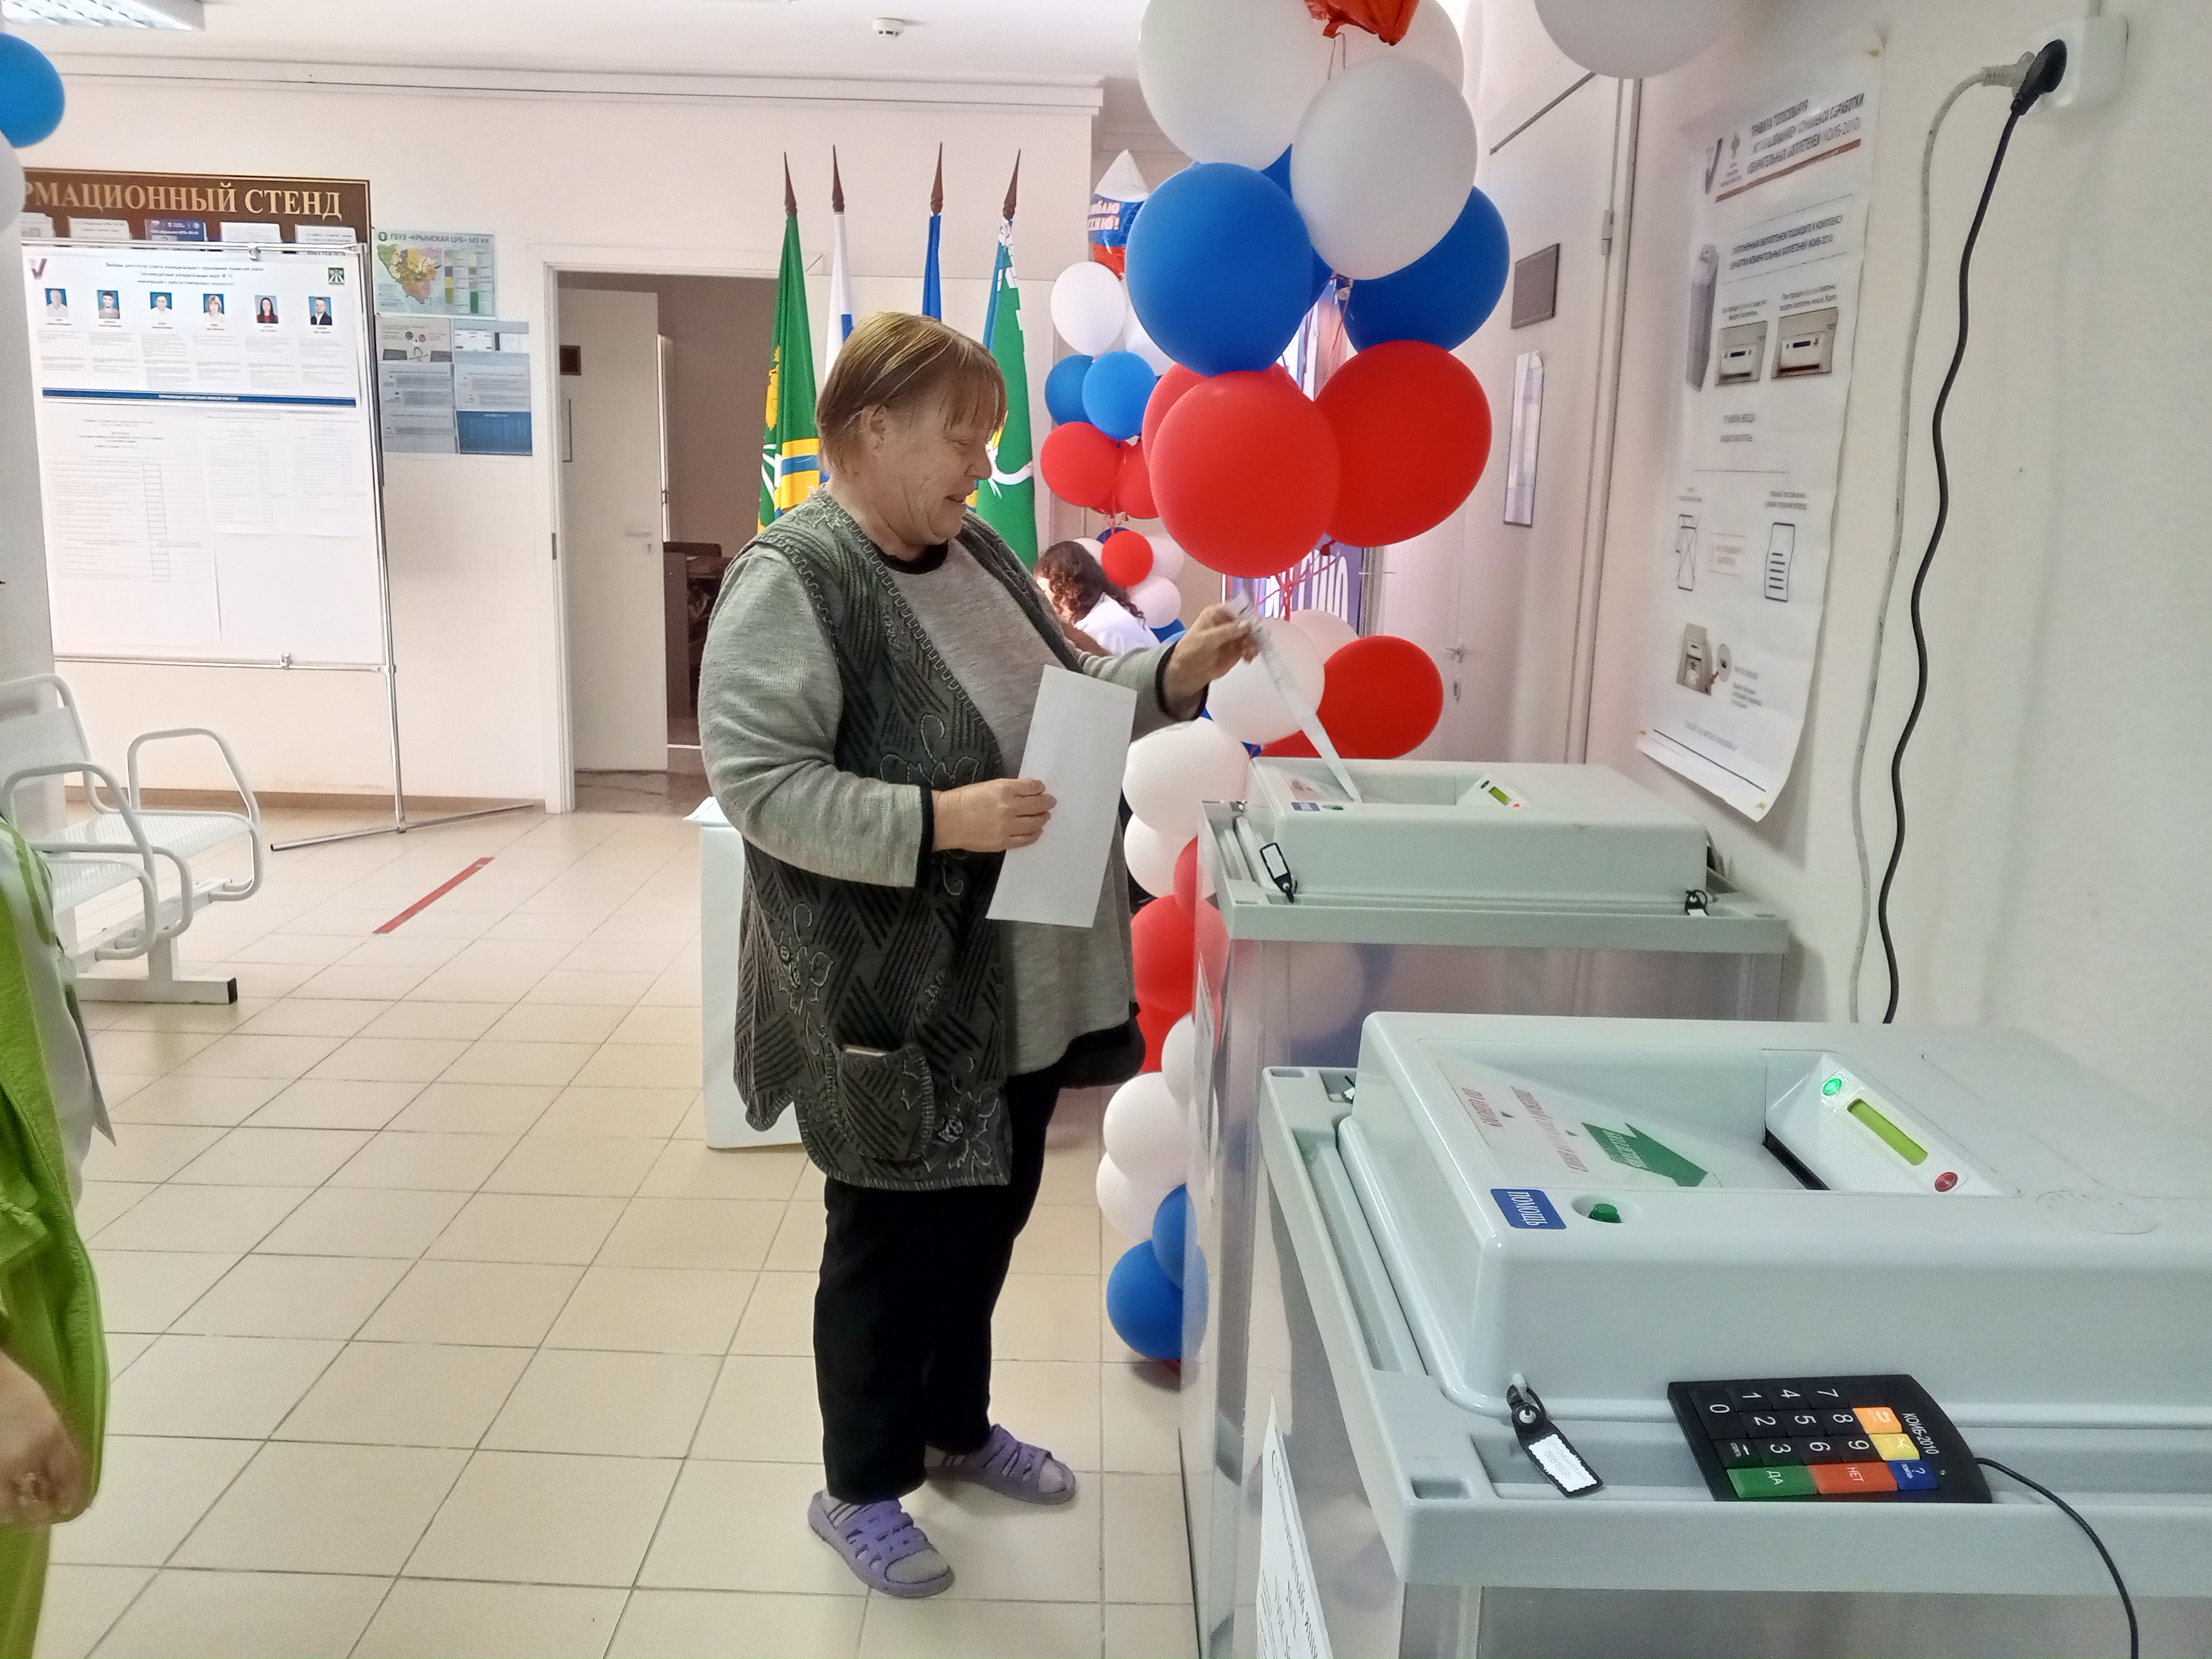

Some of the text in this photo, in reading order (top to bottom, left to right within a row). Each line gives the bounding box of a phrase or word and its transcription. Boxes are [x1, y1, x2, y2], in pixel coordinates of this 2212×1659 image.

[245, 189, 342, 222] СТЕНД
[1507, 1191, 1548, 1226] ПОМОЩЬ
[1781, 1389, 1801, 1398] 4
[1817, 1388, 1839, 1398] 7
[1710, 1404, 1730, 1414] 0
[1753, 1416, 1776, 1426] 2
[1795, 1415, 1817, 1424] 5
[1833, 1414, 1854, 1423] 8
[1902, 1413, 1939, 1454] КОИБ-2010
[1770, 1443, 1792, 1454] 3
[1809, 1441, 1831, 1452] 6
[1848, 1440, 1870, 1450] 9
[1766, 1471, 1784, 1485] ДА
[1846, 1467, 1864, 1482] НЕТ
